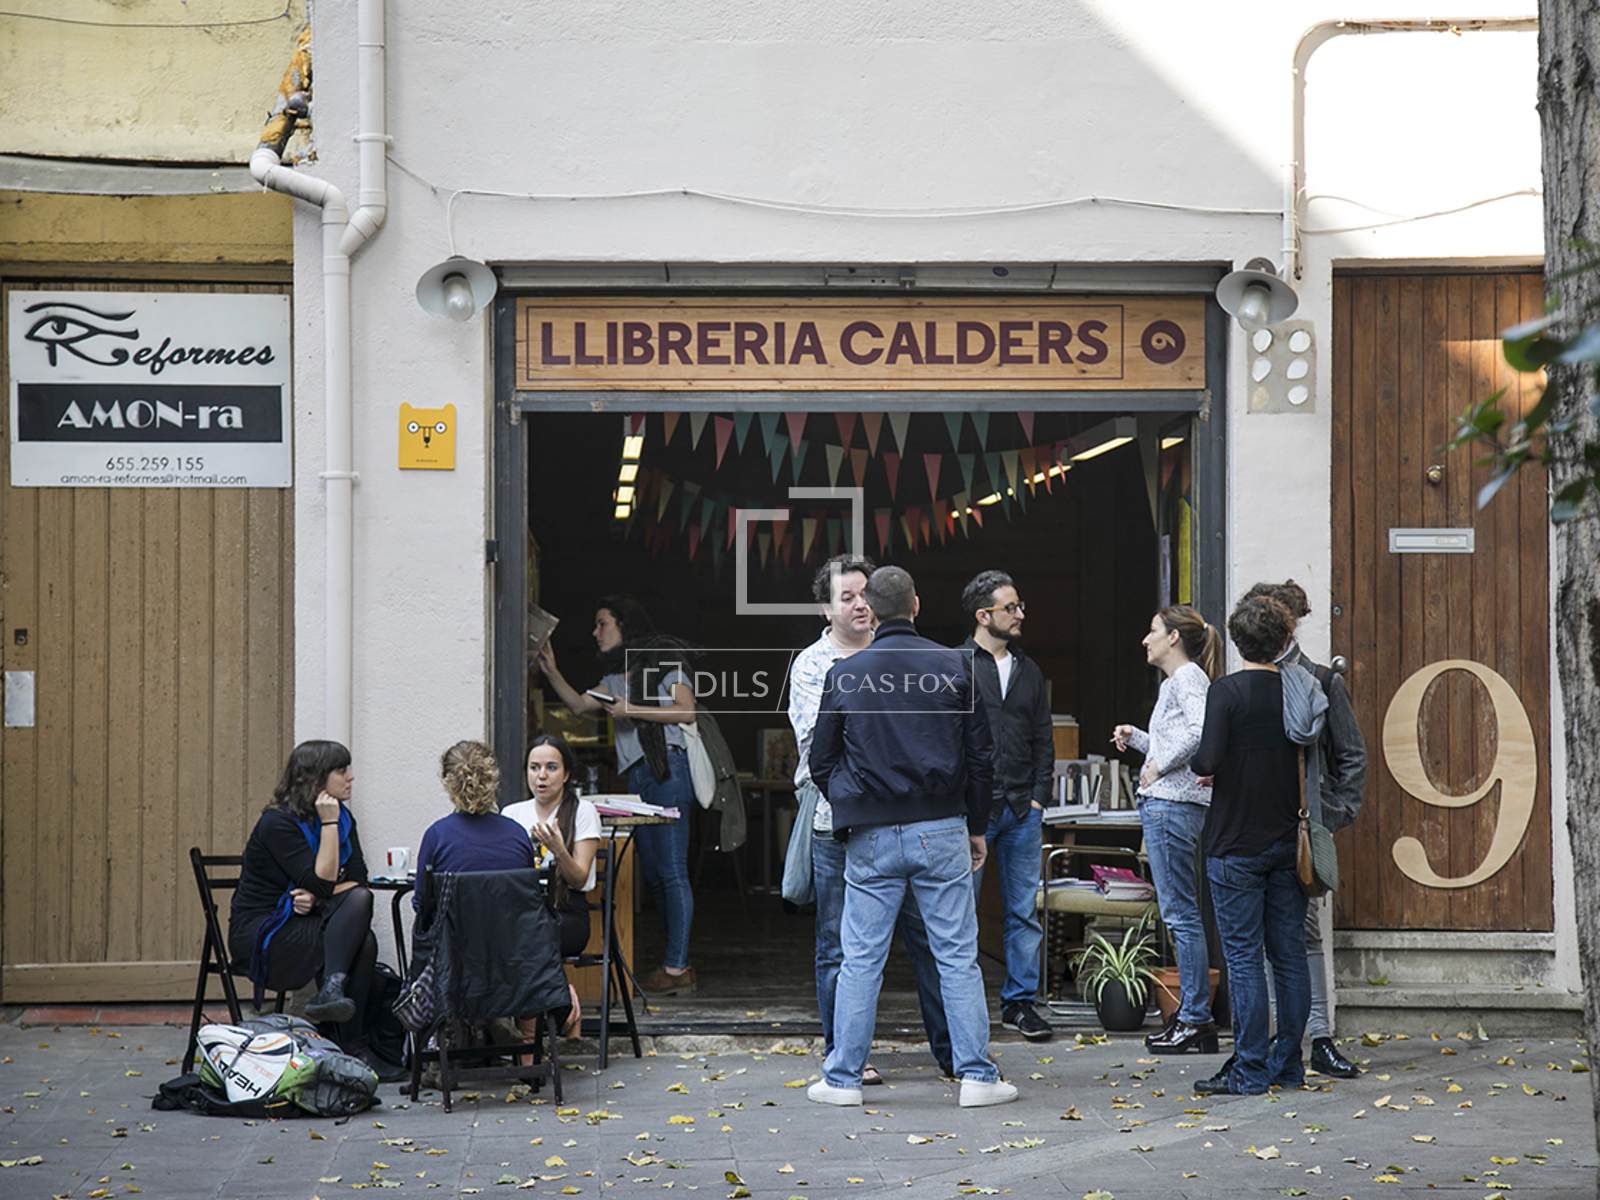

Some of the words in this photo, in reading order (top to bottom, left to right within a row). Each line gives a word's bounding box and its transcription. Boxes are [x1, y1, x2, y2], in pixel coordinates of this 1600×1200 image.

[540, 321, 828, 365] LLIBRERIA
[839, 320, 1109, 365] CALDERS
[57, 400, 243, 429] AMON-ra
[60, 474, 247, 485] amon-ra-reformes@hotmail.com
[105, 457, 204, 471] 655.259.155
[1382, 659, 1537, 888] 9
[219, 1060, 262, 1097] HEAD
